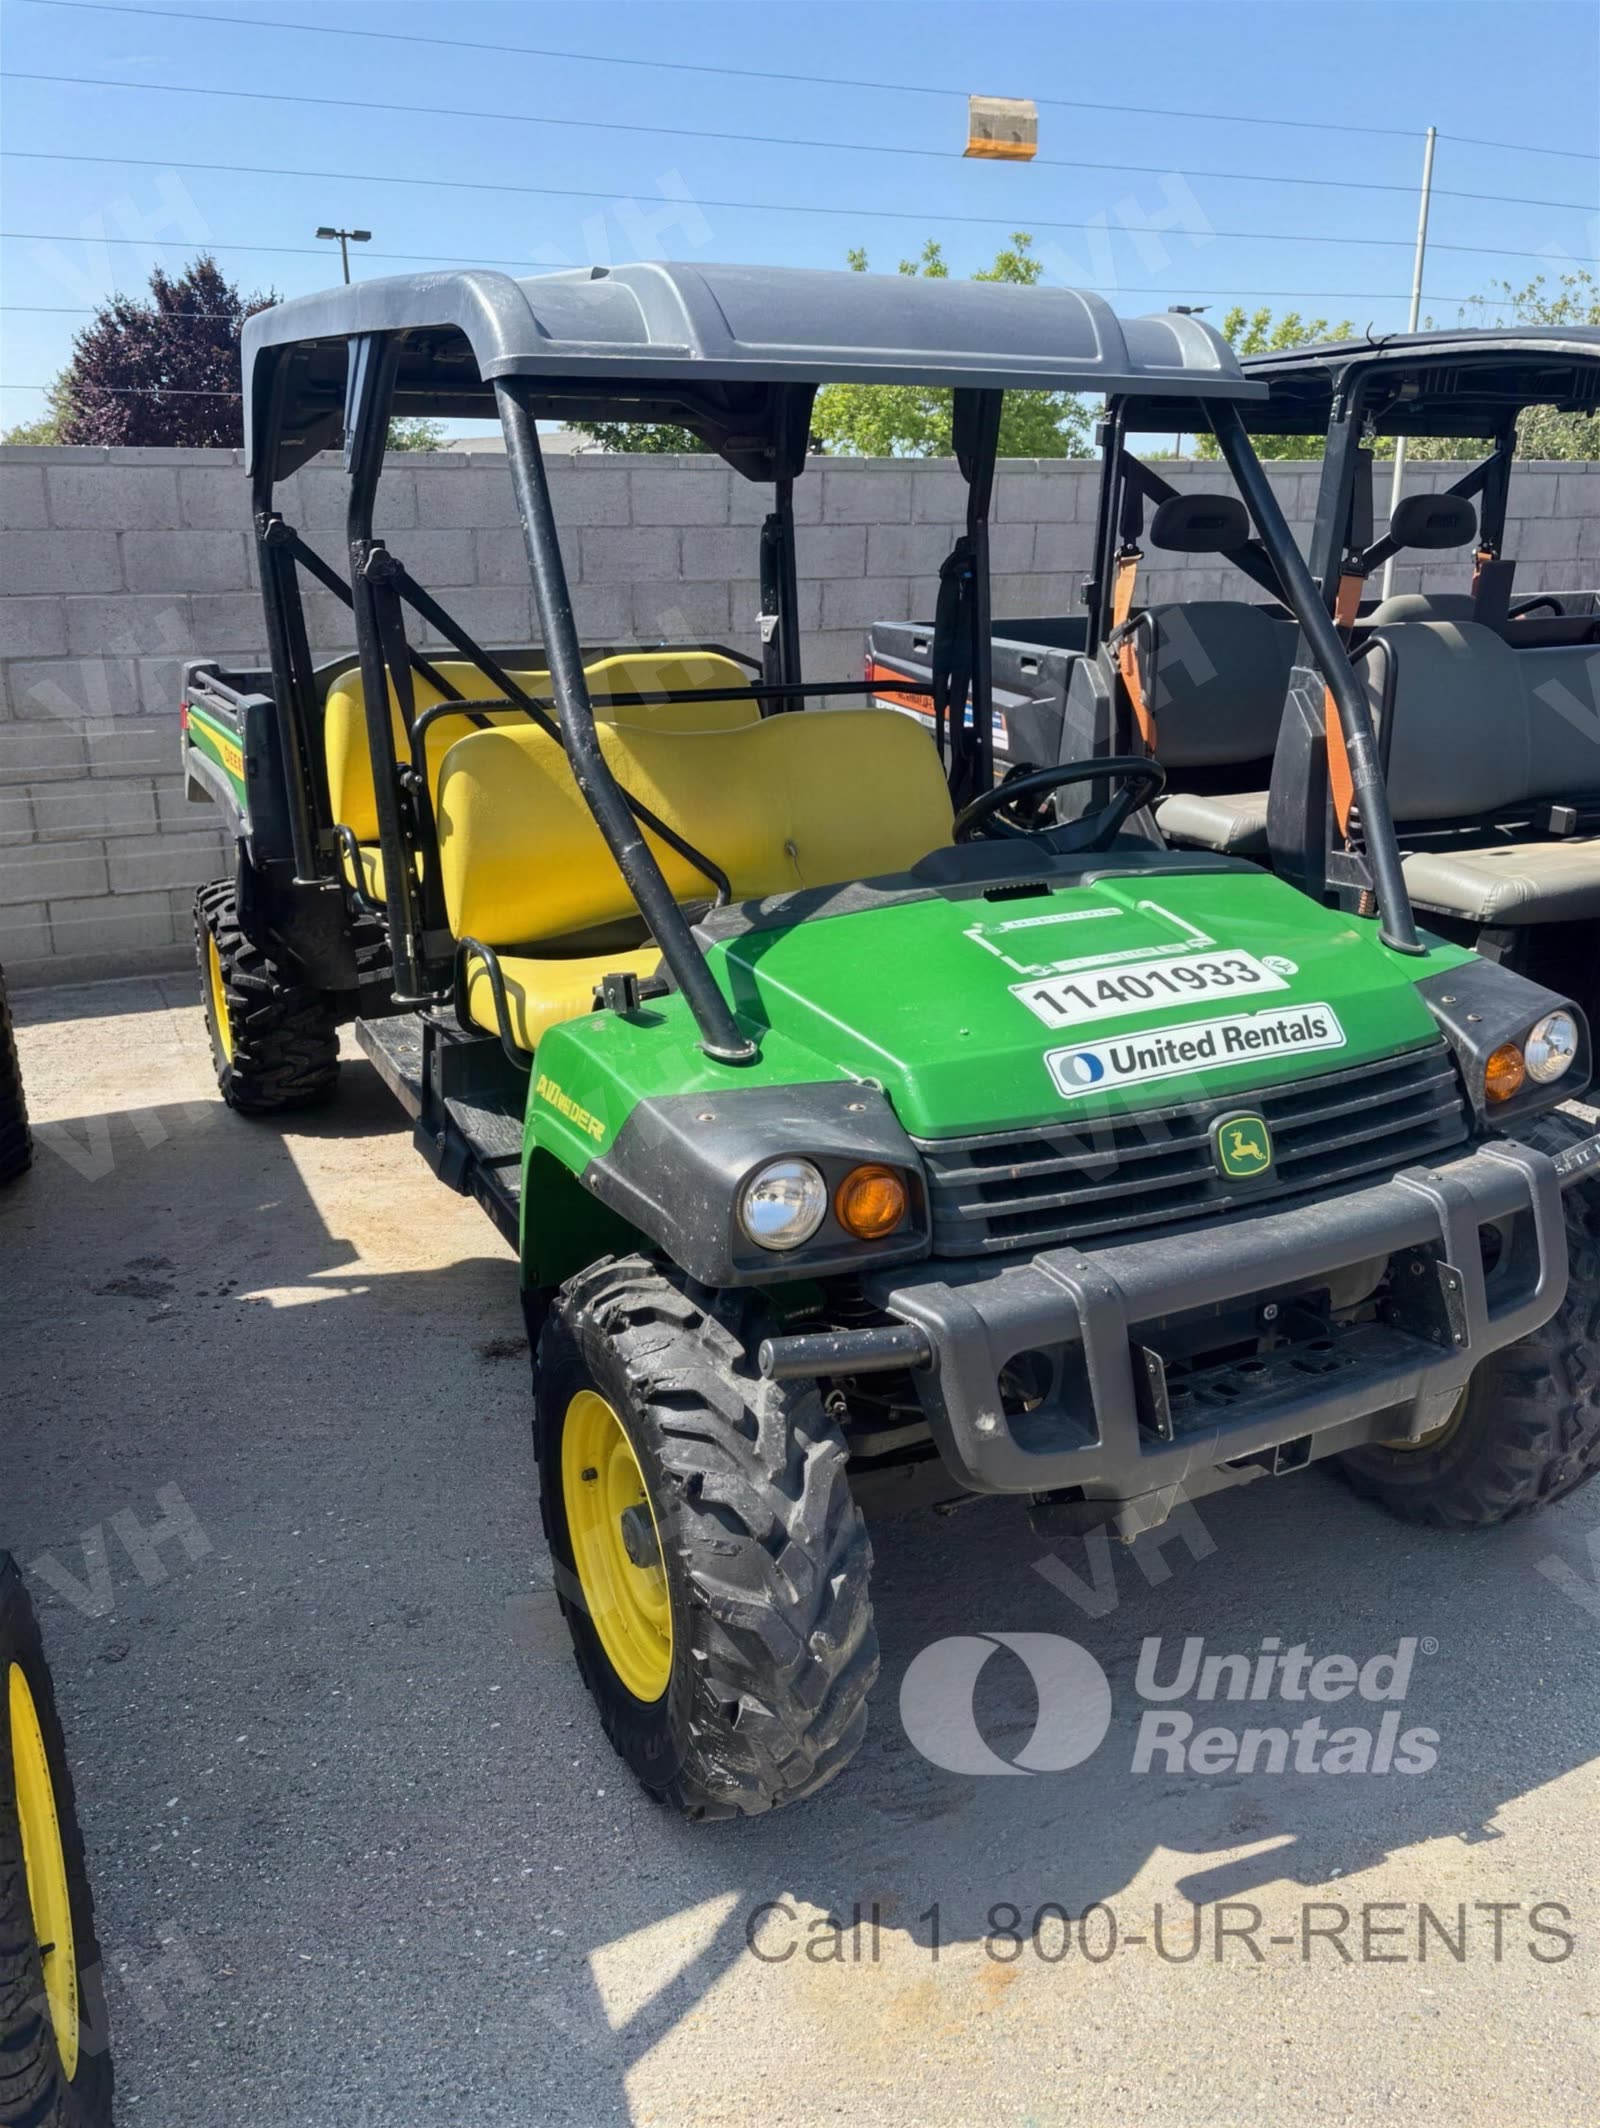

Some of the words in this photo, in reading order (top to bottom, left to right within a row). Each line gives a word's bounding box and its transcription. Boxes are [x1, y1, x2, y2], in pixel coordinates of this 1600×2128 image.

[1031, 959, 1261, 1015] 11401933
[1109, 1030, 1217, 1076] United
[1221, 1013, 1329, 1053] Rentals
